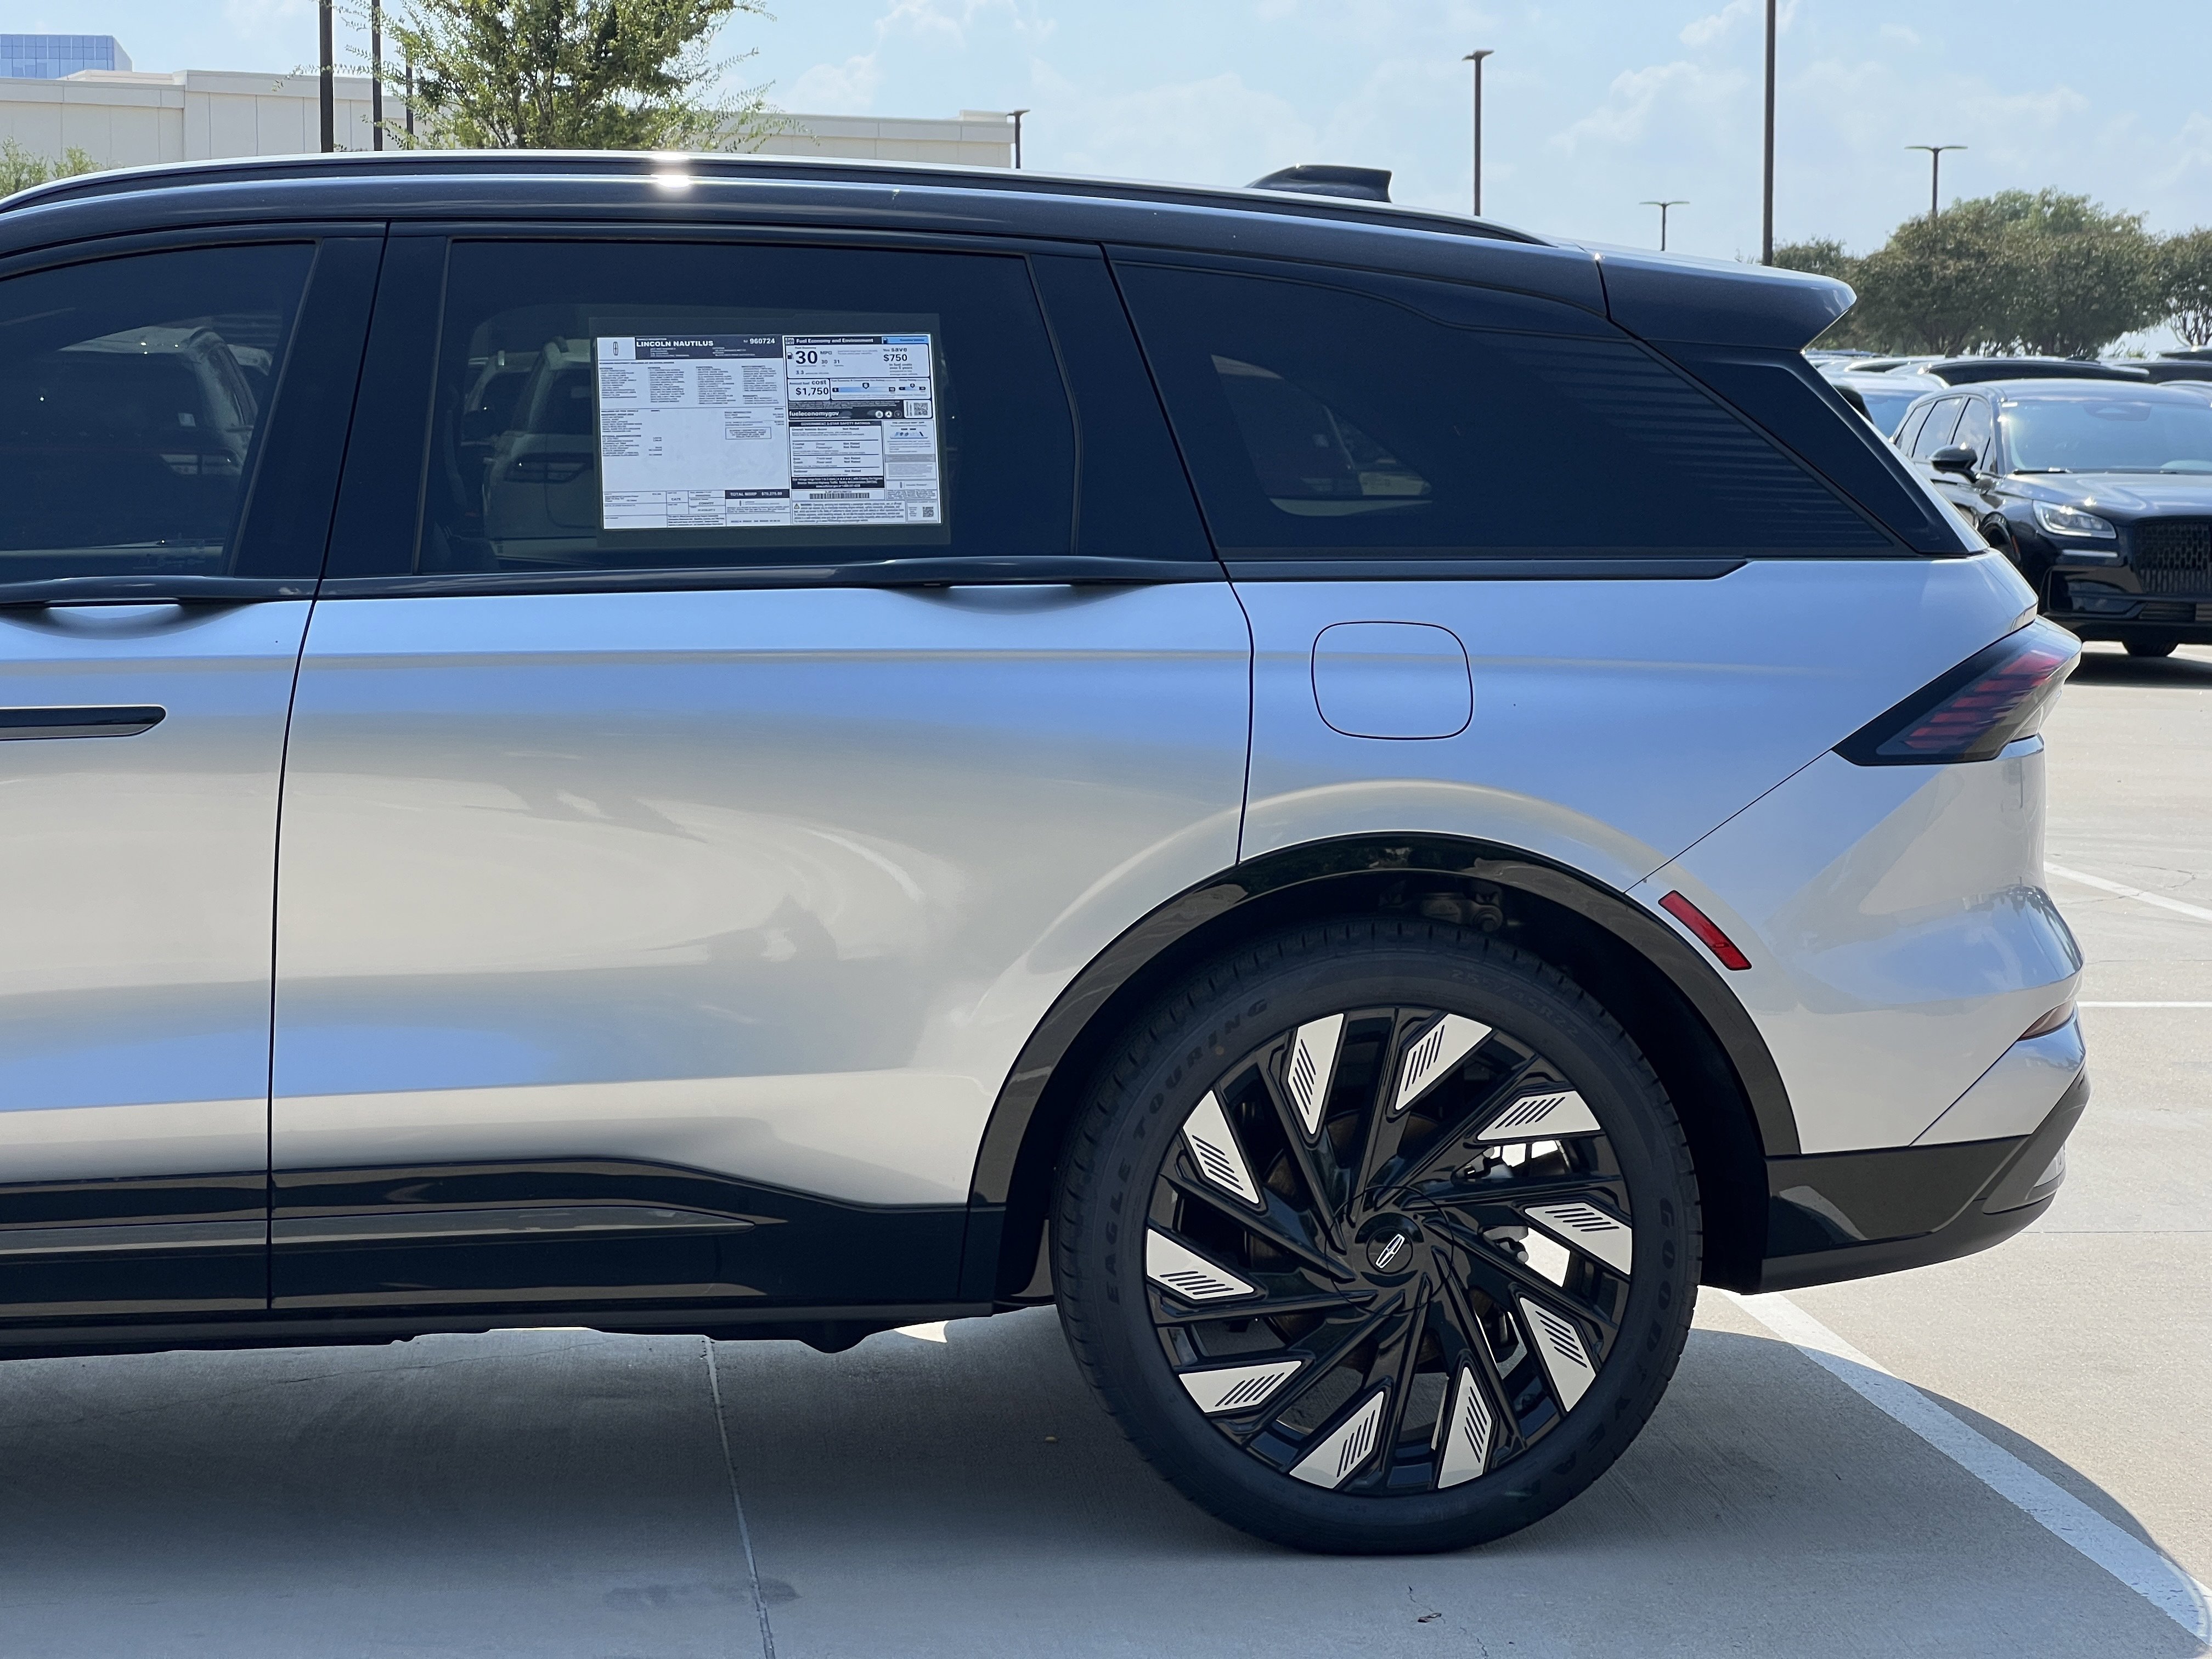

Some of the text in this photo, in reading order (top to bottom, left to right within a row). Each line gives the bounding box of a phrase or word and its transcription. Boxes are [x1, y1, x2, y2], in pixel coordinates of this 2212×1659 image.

[795, 351, 817, 364] 30
[795, 387, 828, 396] $1,750
[1104, 998, 1268, 1305] EAGLE TOURING
